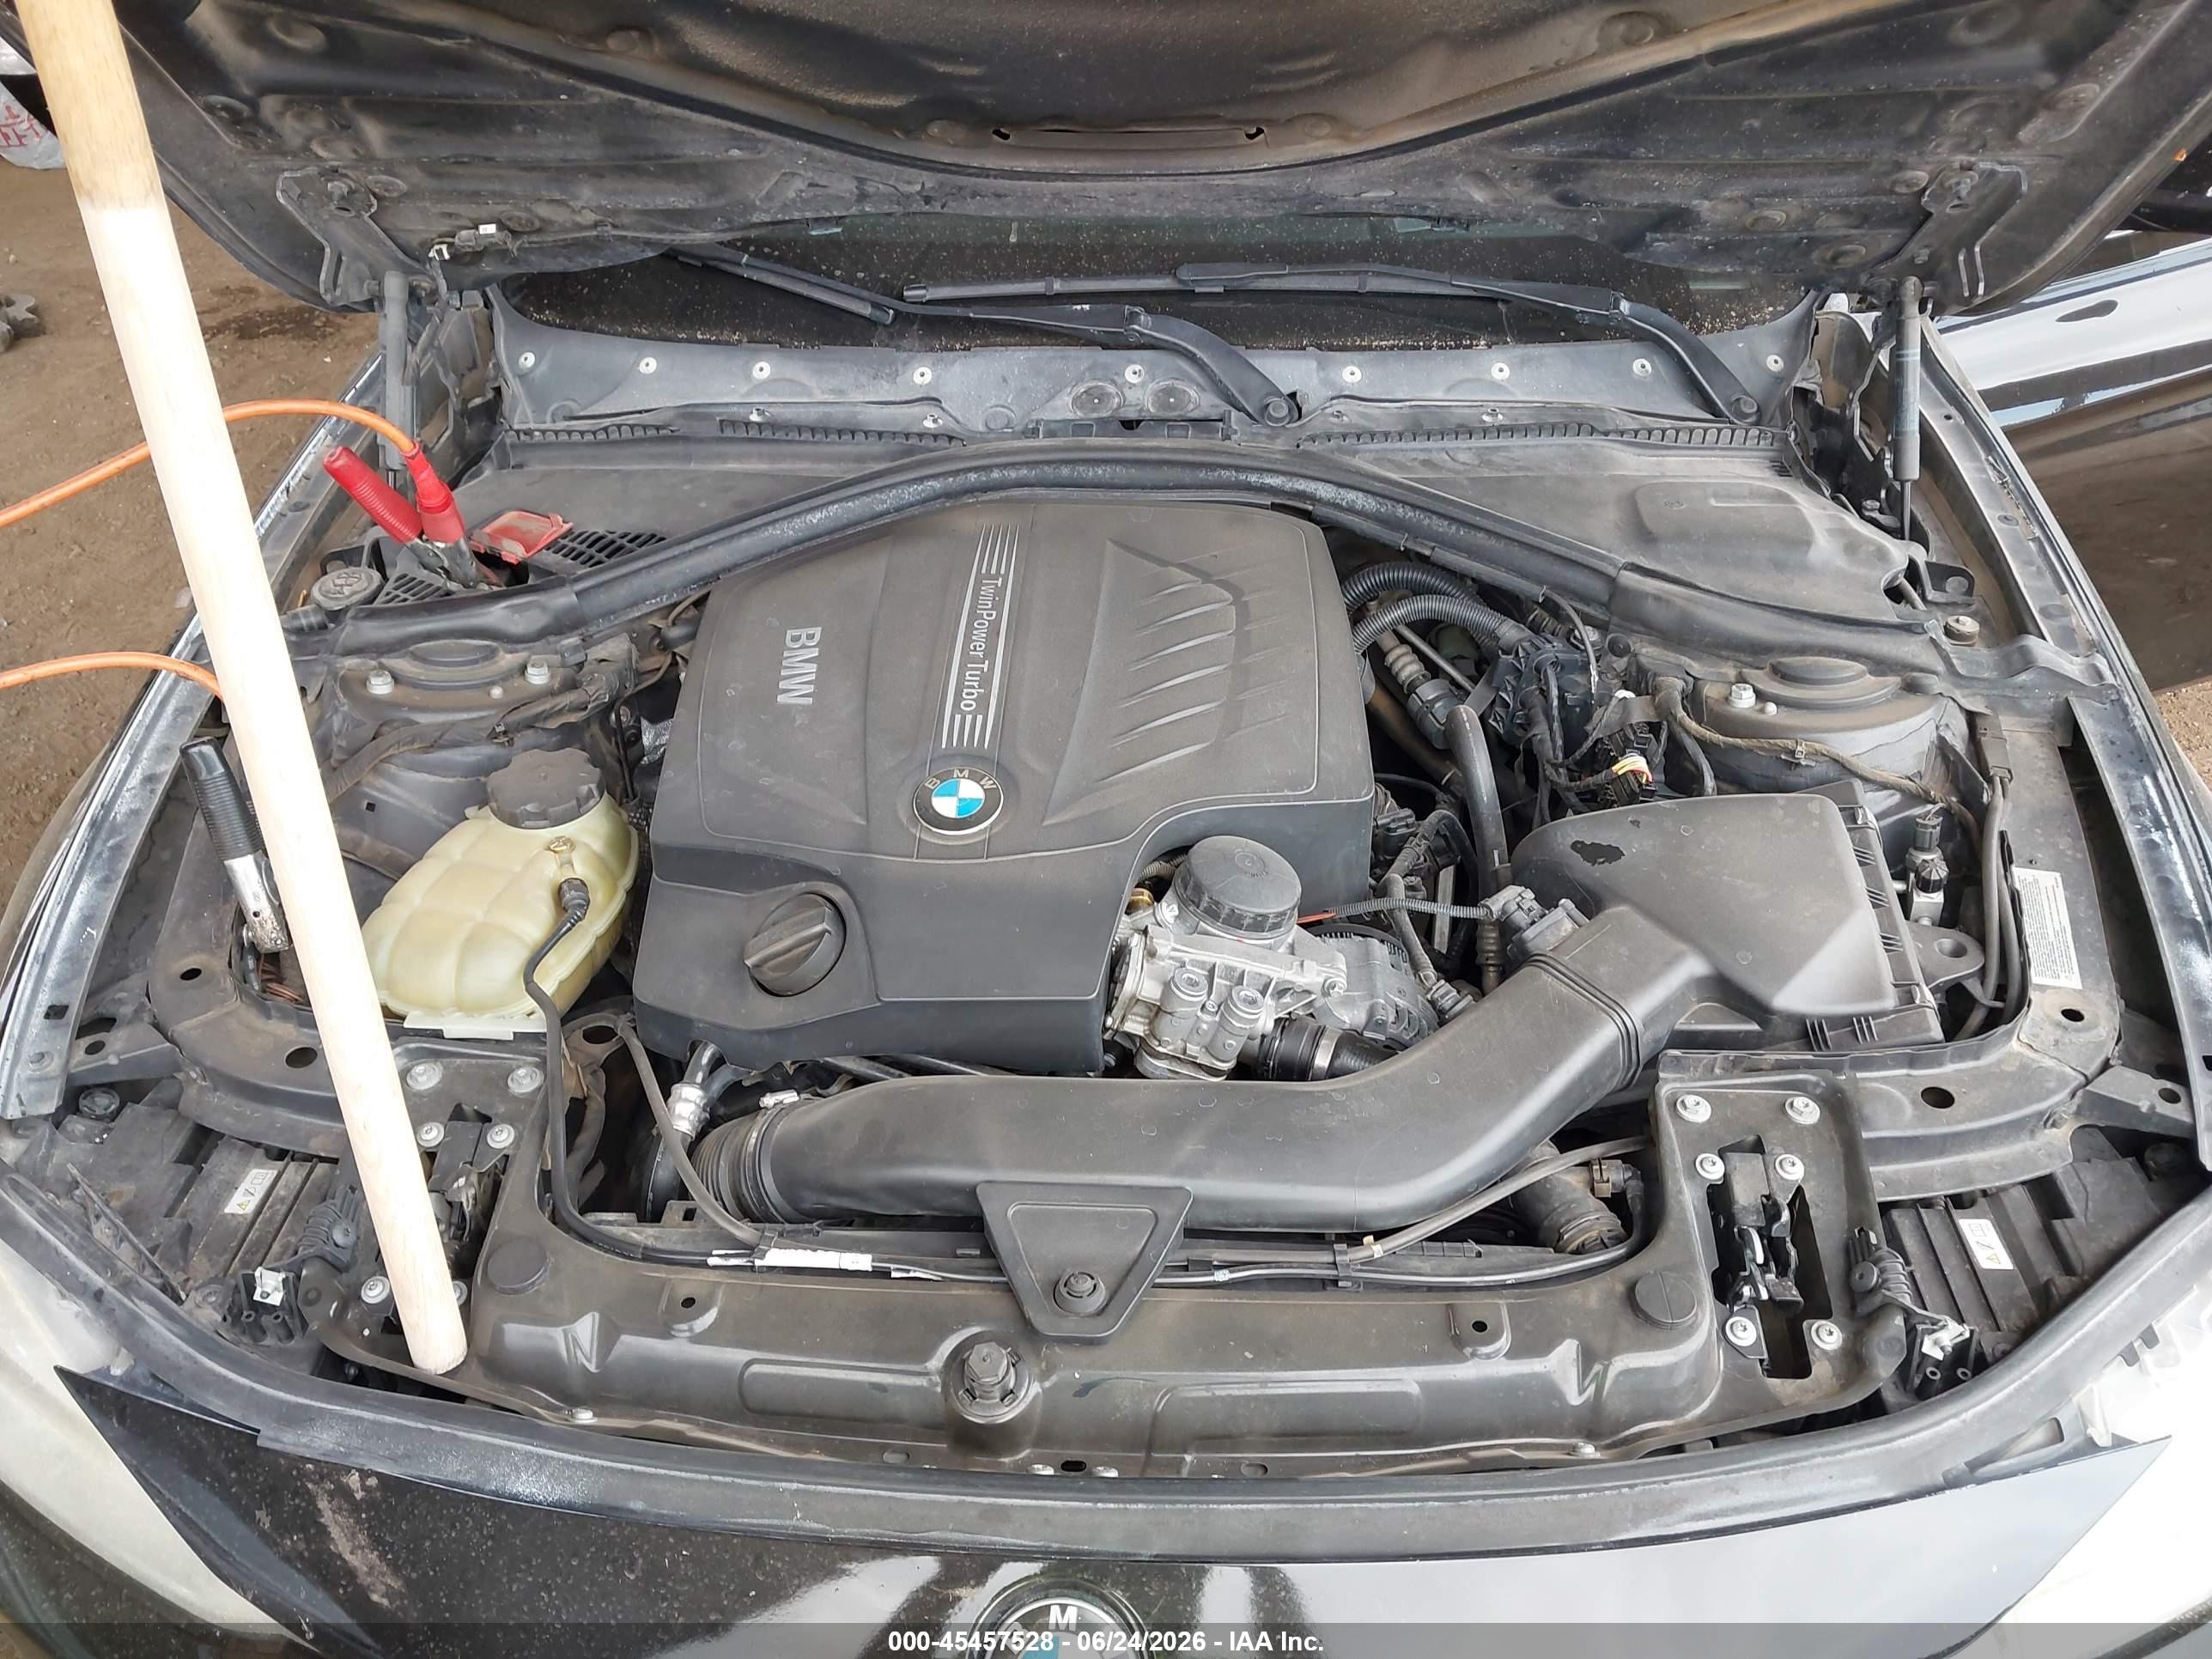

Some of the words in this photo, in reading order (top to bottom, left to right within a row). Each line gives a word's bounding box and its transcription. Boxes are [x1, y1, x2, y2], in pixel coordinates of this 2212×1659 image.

[969, 577, 1002, 659] TwinPower
[776, 627, 822, 704] BMW
[960, 659, 988, 711] Turbo
[924, 769, 997, 790] BMW
